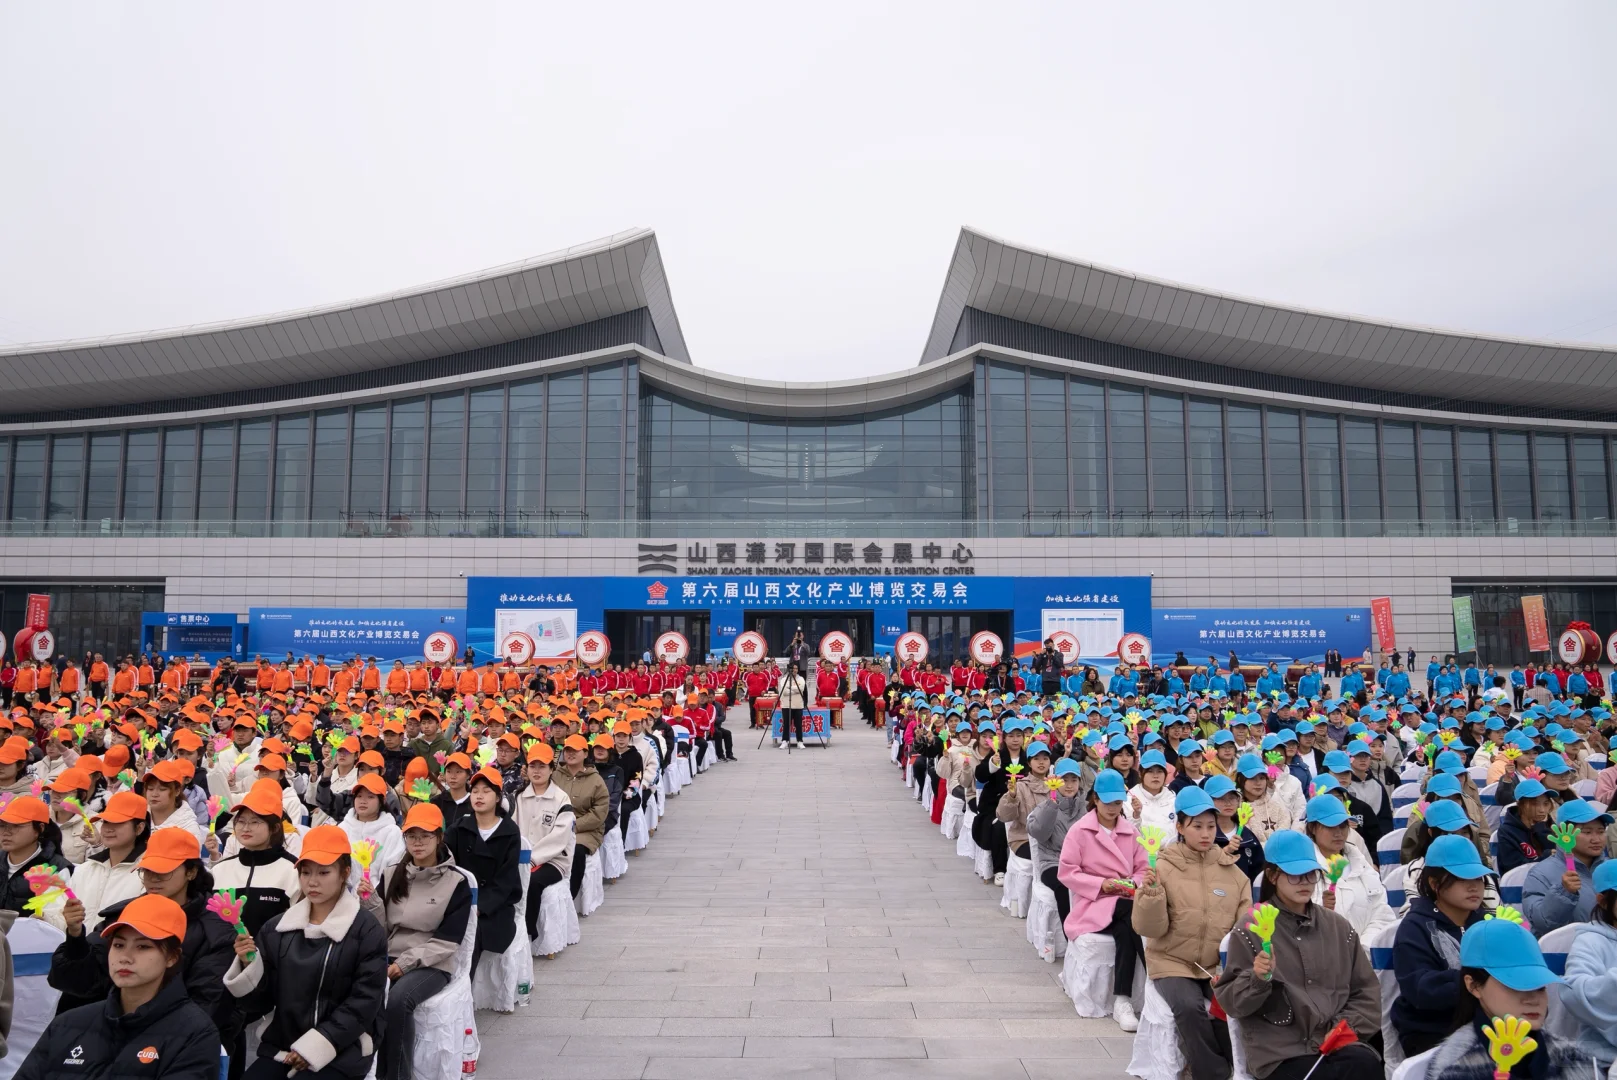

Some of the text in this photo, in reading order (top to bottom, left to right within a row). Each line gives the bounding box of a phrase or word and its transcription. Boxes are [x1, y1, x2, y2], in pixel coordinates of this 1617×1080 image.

[687, 542, 973, 564] 山西潇河国际会展中心
[687, 567, 975, 575] SHANXI XIAOHE INTERNATIONAL CONVENTION & EXHIBITION CENTER
[682, 582, 967, 598] 第六届山西文化产业博览交易会
[293, 629, 420, 639] 第六届山西文化产业博览交易会
[1199, 629, 1327, 638] 第六届山西文化产业博览交易会
[137, 1051, 159, 1060] CUBA
